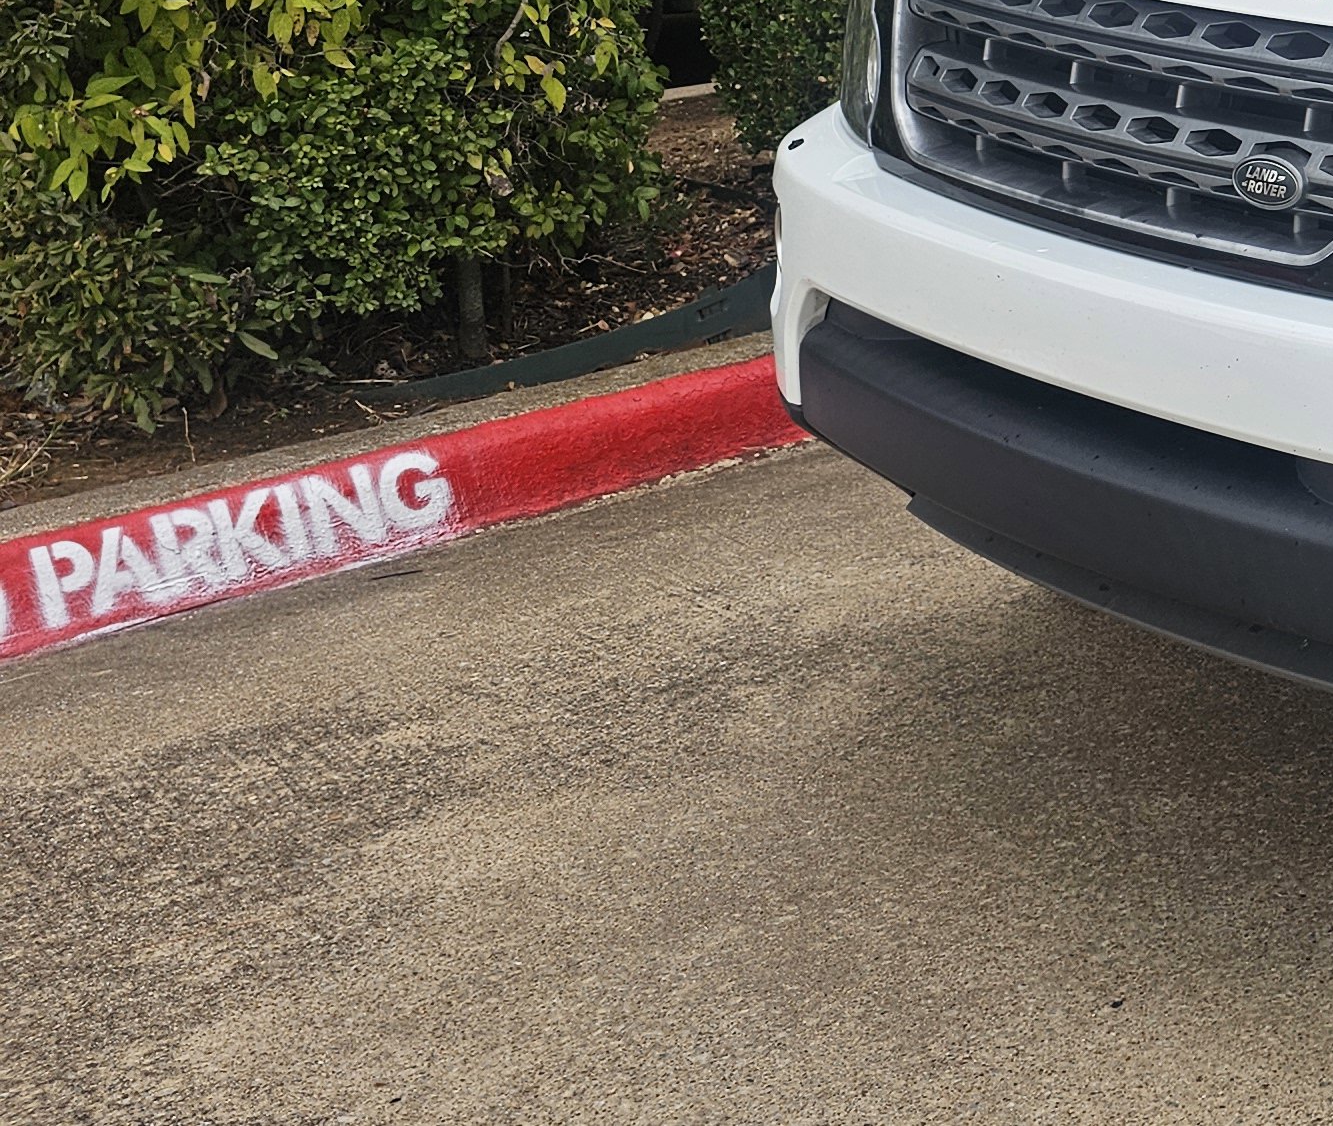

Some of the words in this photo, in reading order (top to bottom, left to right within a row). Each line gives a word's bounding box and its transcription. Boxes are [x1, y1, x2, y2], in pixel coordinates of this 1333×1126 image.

[1246, 165, 1278, 183] LAND
[1247, 180, 1287, 198] ROVER
[29, 450, 455, 631] PARKING
